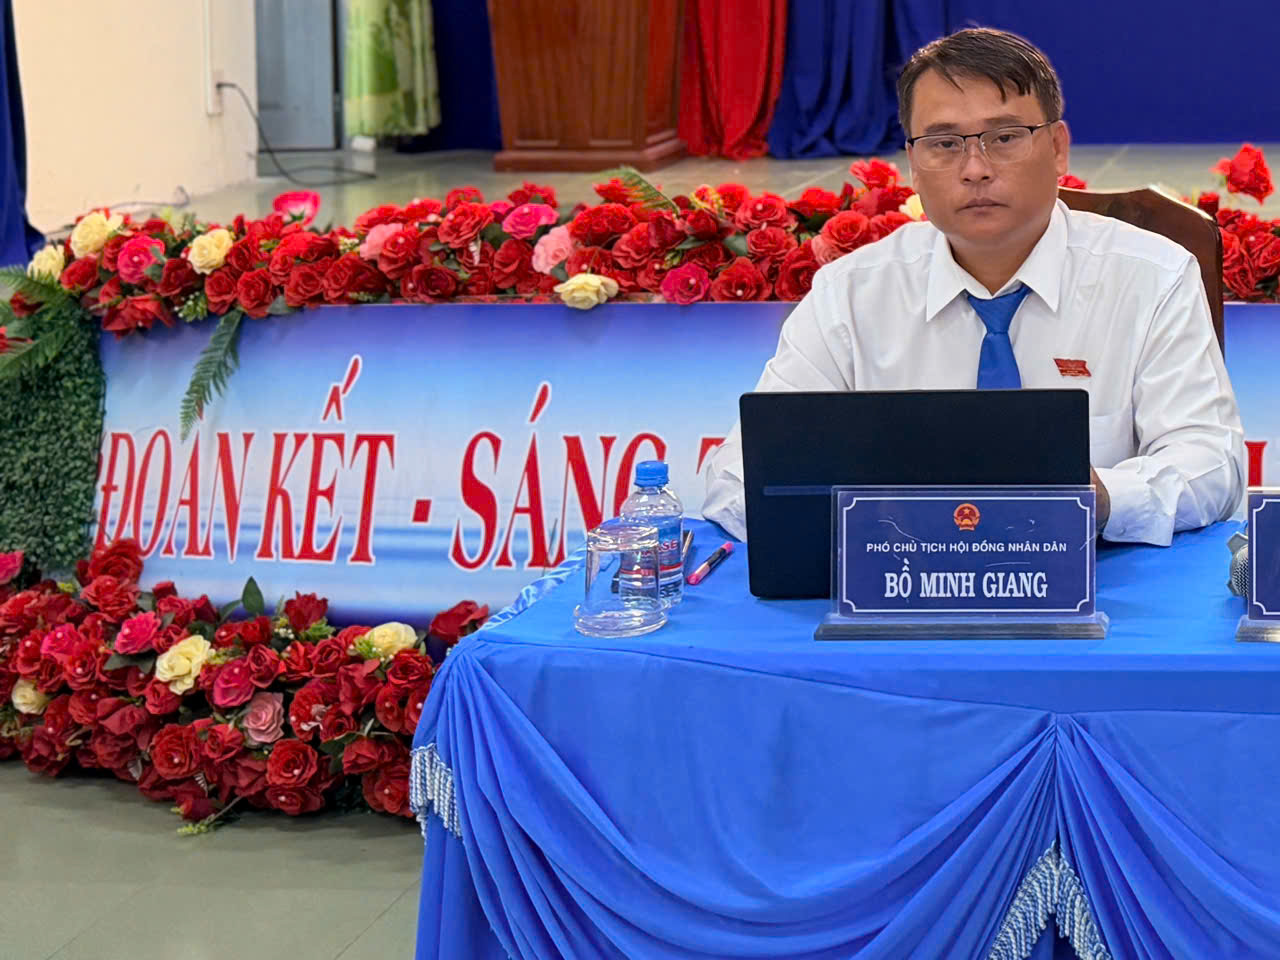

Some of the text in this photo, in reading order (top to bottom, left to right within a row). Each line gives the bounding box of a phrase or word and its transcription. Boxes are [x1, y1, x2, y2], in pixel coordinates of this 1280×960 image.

[256, 357, 395, 564] KẾT
[867, 541, 890, 553] PHÓ
[893, 540, 917, 553] CHỦ
[920, 542, 947, 554] TỊCH
[949, 540, 969, 554] HỘI
[1008, 540, 1040, 553] NHÂN
[1043, 540, 1067, 552] DÂN
[884, 558, 1048, 598] BỒ MINH GIANG
